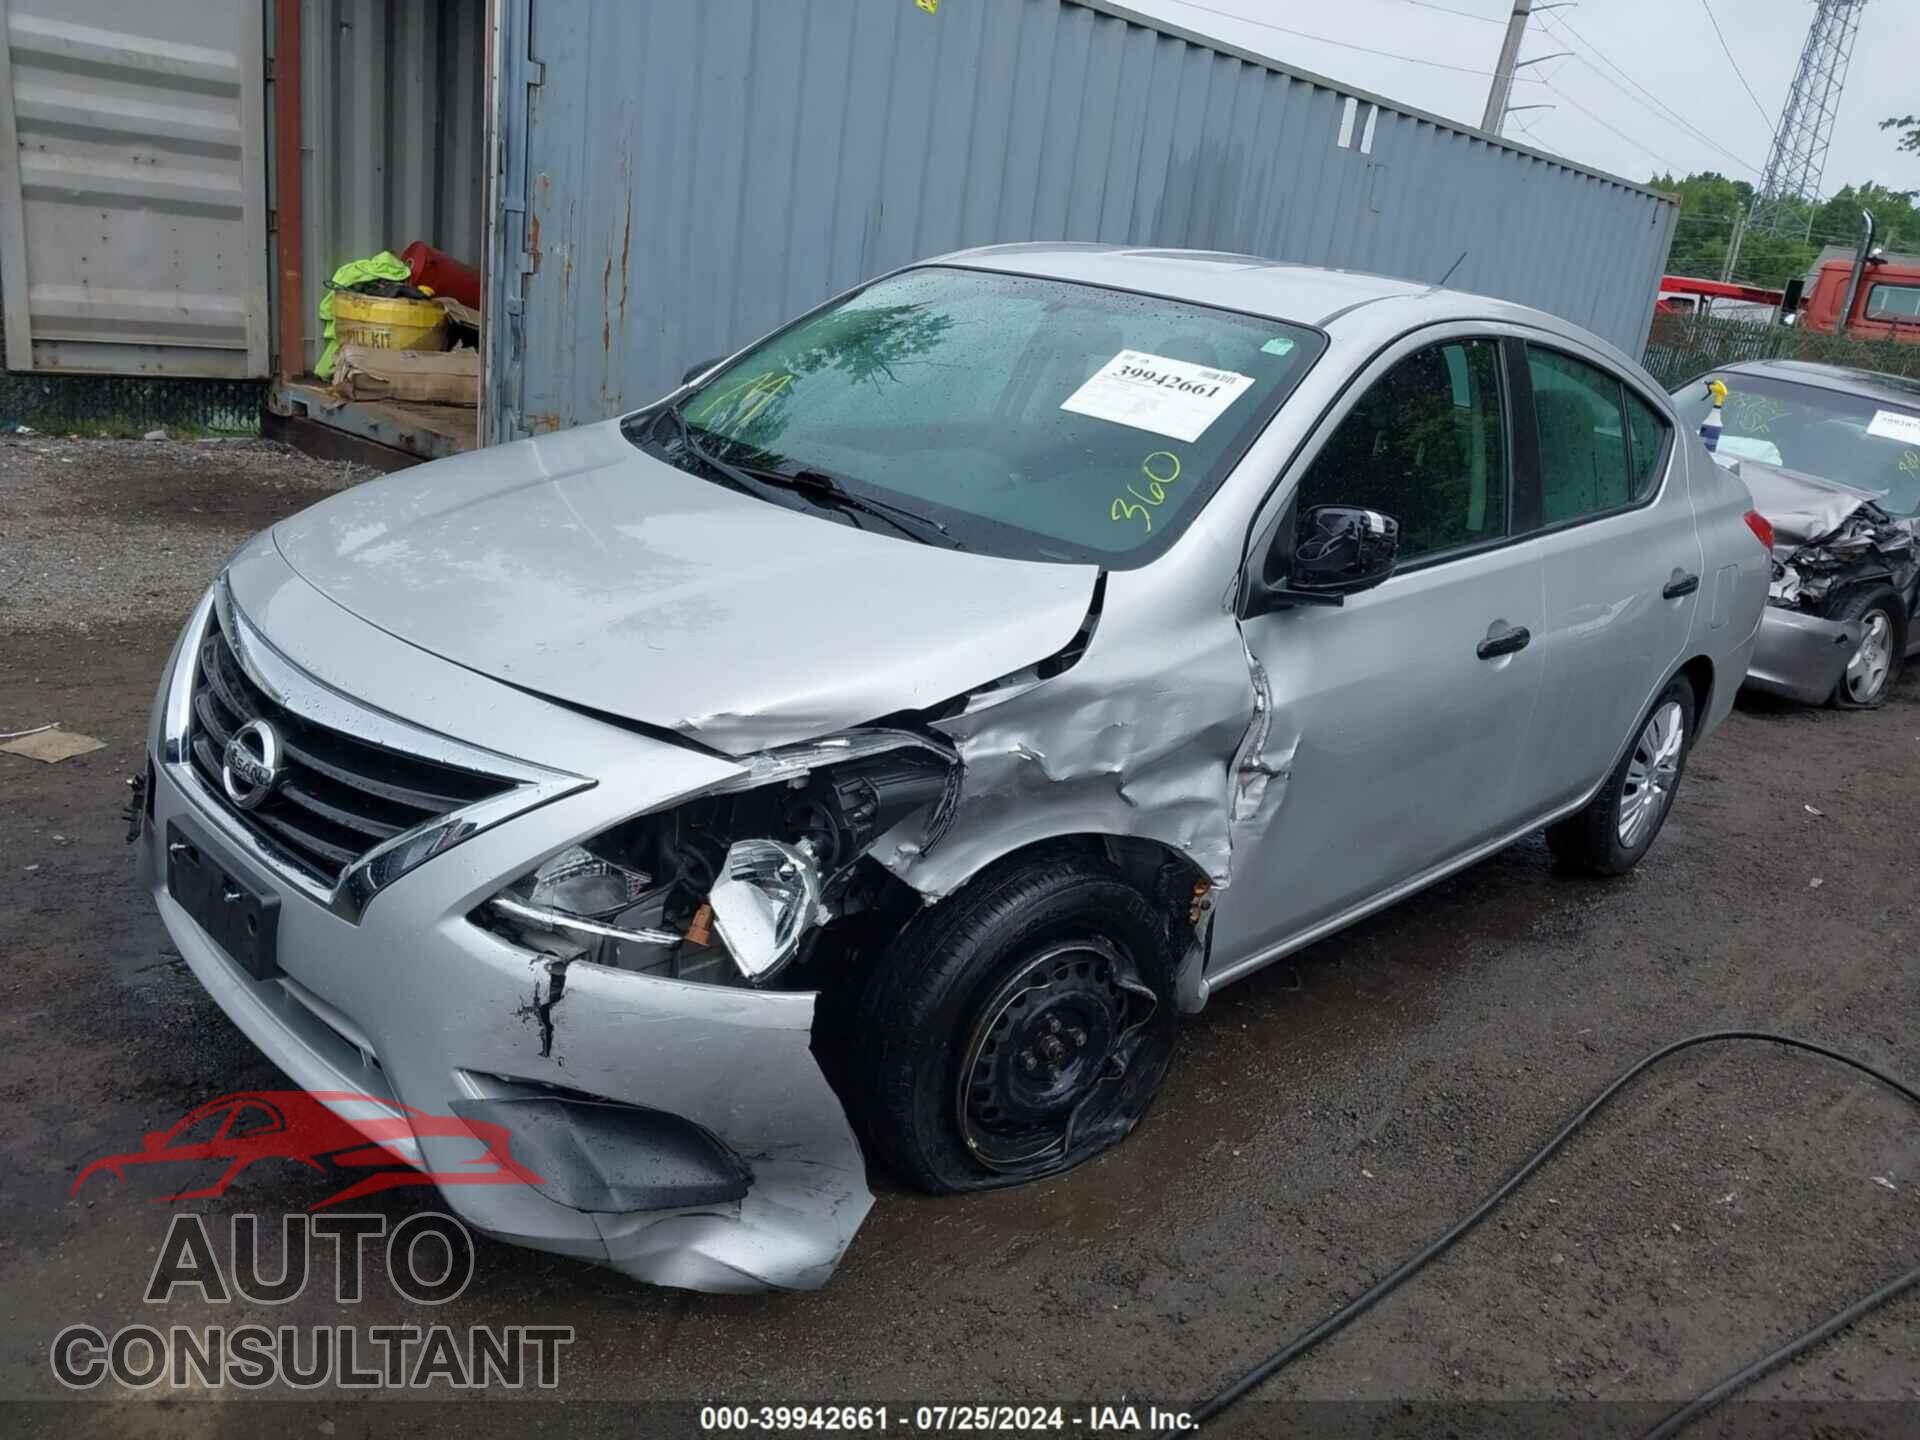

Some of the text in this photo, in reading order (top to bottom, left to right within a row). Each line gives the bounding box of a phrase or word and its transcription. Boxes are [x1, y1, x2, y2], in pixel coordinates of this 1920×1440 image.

[370, 331, 392, 349] KIT
[1112, 365, 1220, 398] 39942661
[1111, 451, 1181, 532] 360
